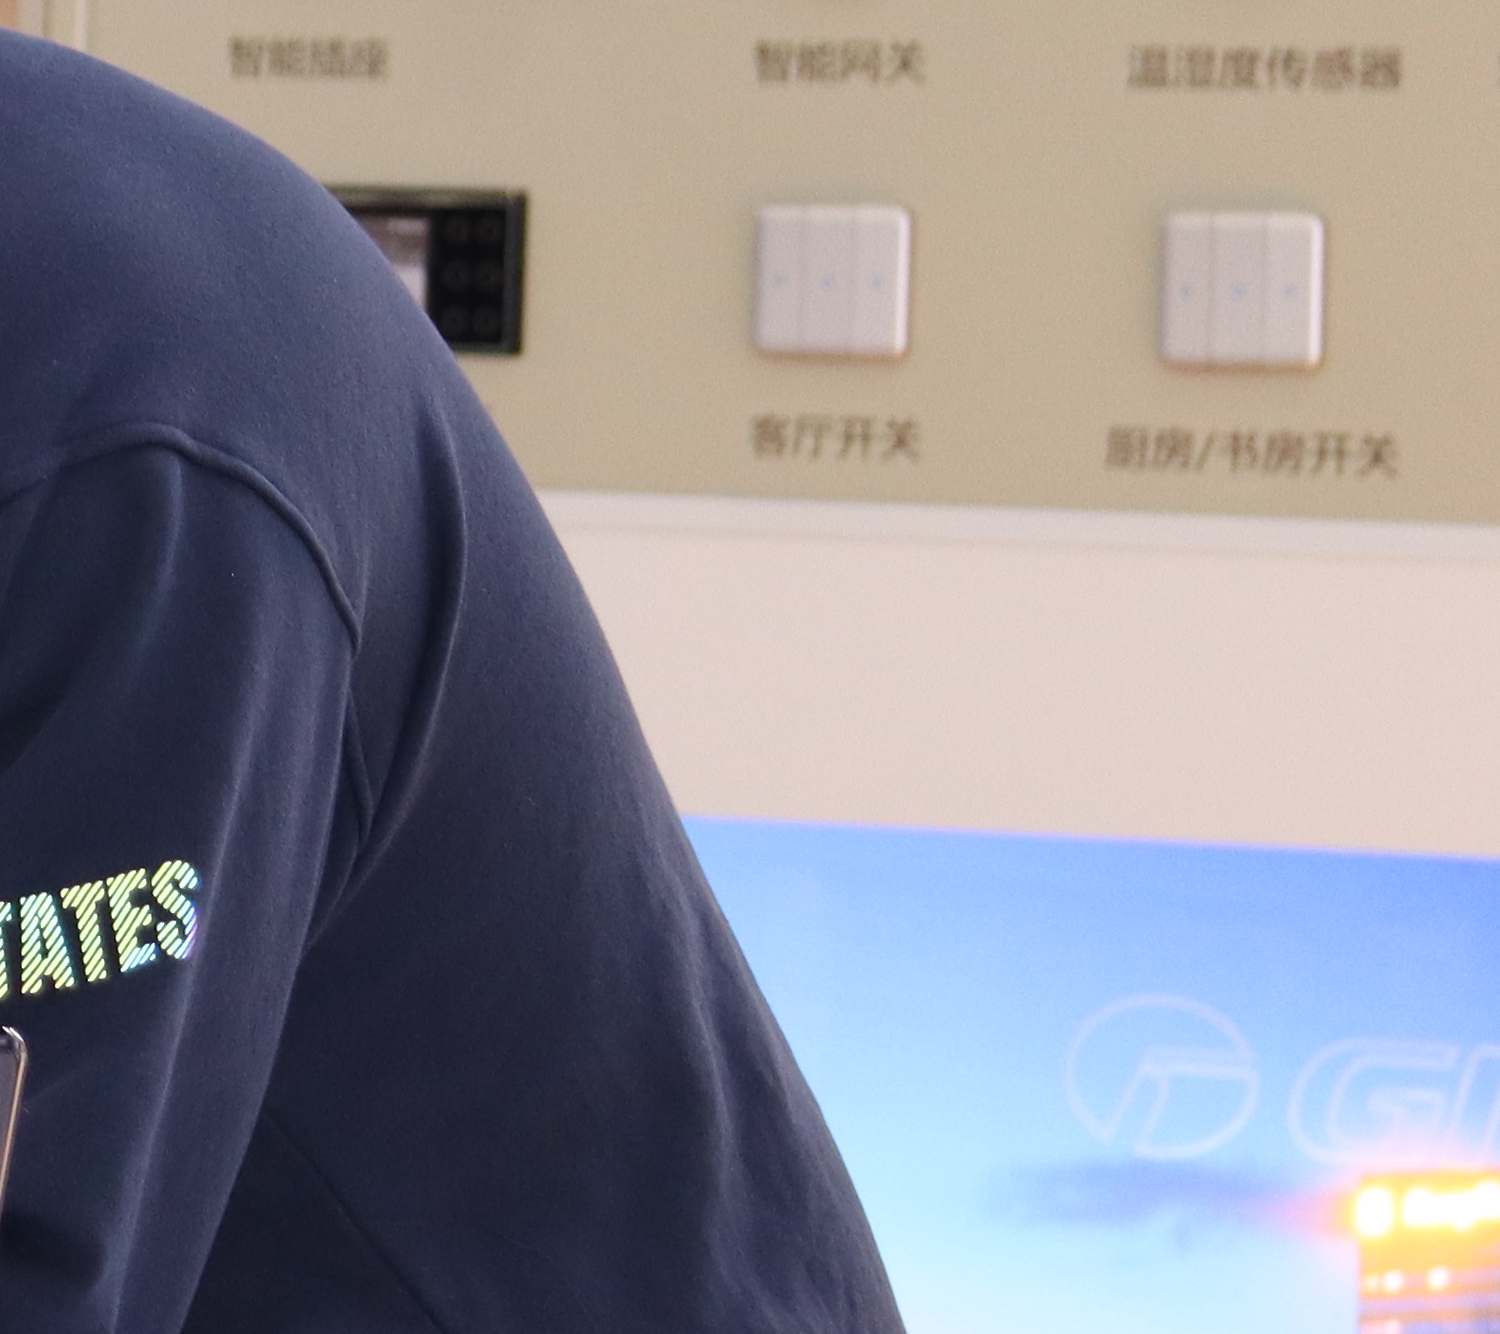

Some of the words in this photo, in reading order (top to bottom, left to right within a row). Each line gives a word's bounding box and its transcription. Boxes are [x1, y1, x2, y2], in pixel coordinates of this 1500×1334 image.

[1126, 44, 1403, 91] 温湿度传感器
[751, 413, 921, 461] 客厅开关
